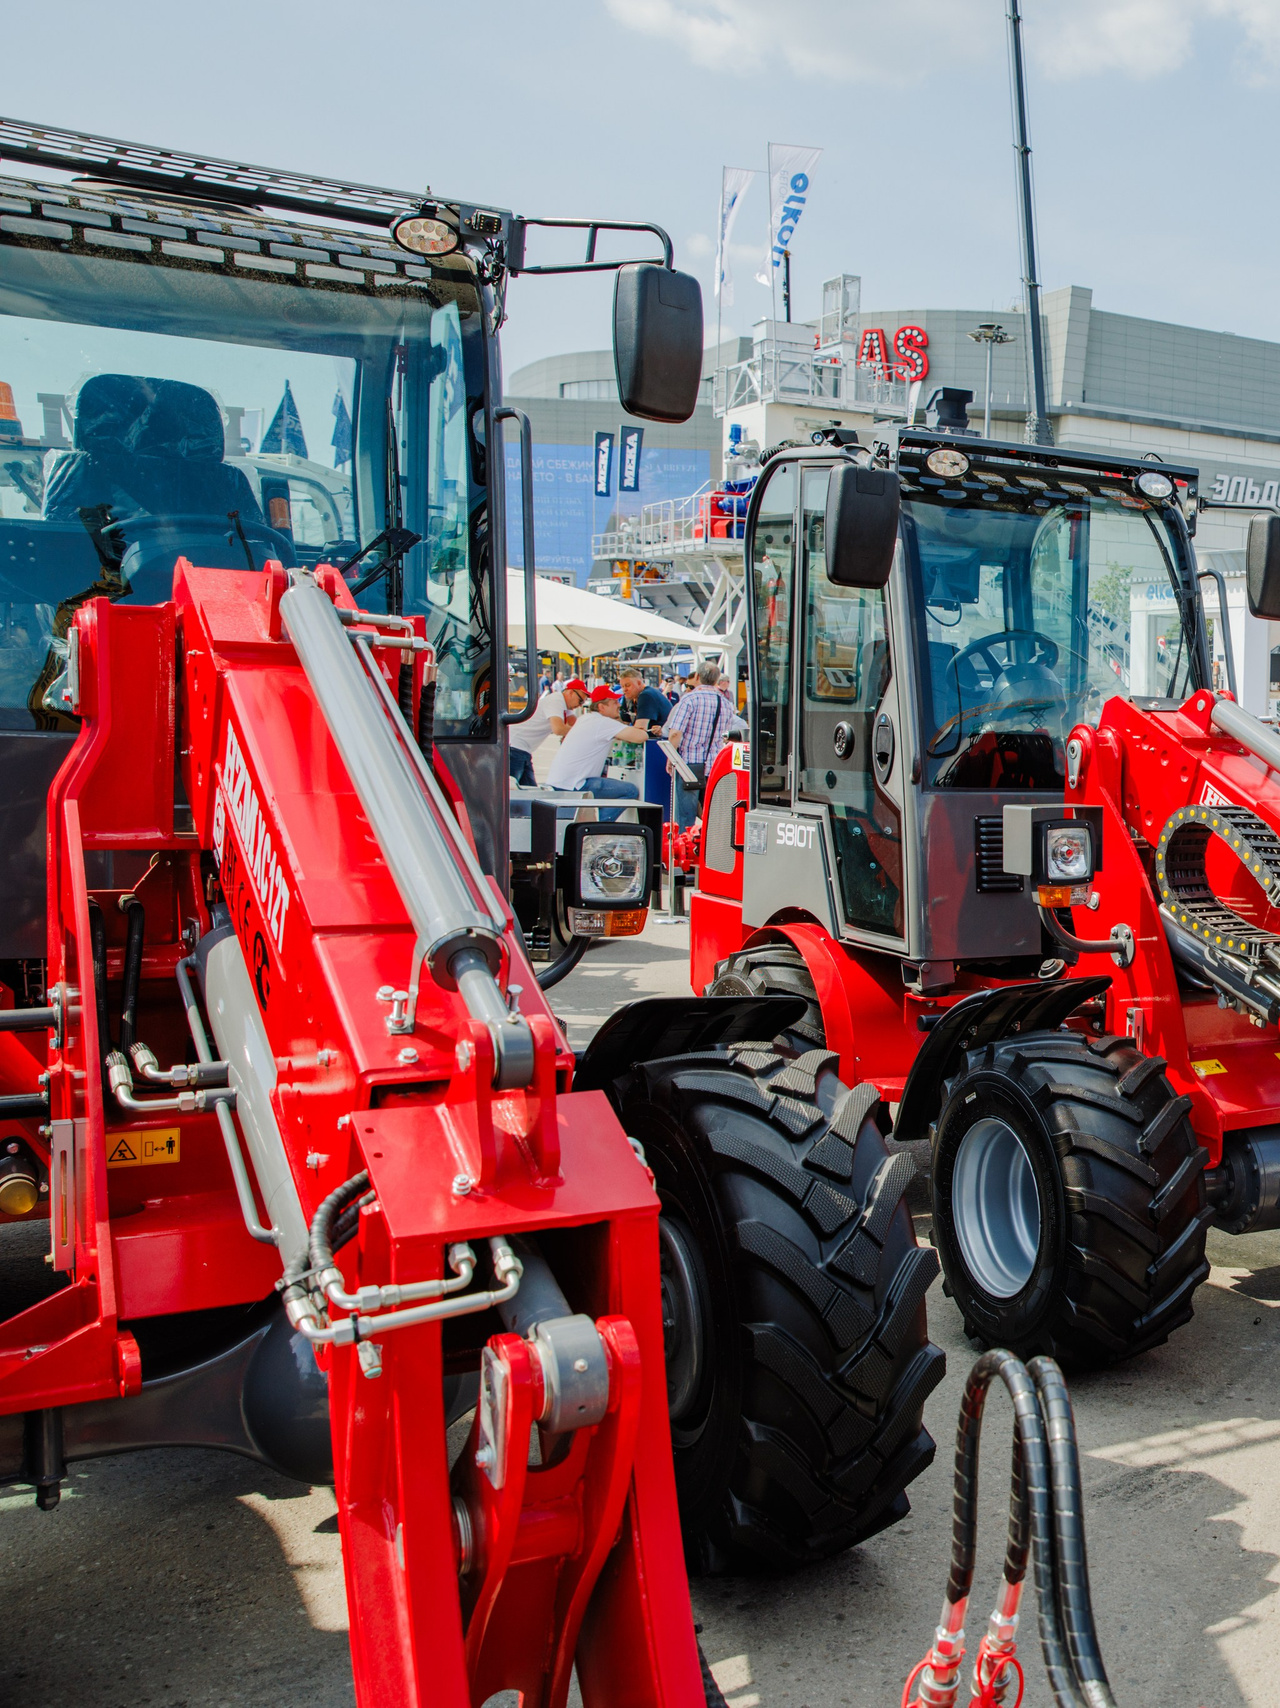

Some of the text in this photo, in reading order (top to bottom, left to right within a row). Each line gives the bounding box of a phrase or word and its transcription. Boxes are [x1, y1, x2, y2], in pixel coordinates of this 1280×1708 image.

[857, 325, 929, 382] AS
[507, 457, 544, 469] ДААЙ
[532, 471, 555, 482] ЕТО
[776, 822, 816, 849] S810T
